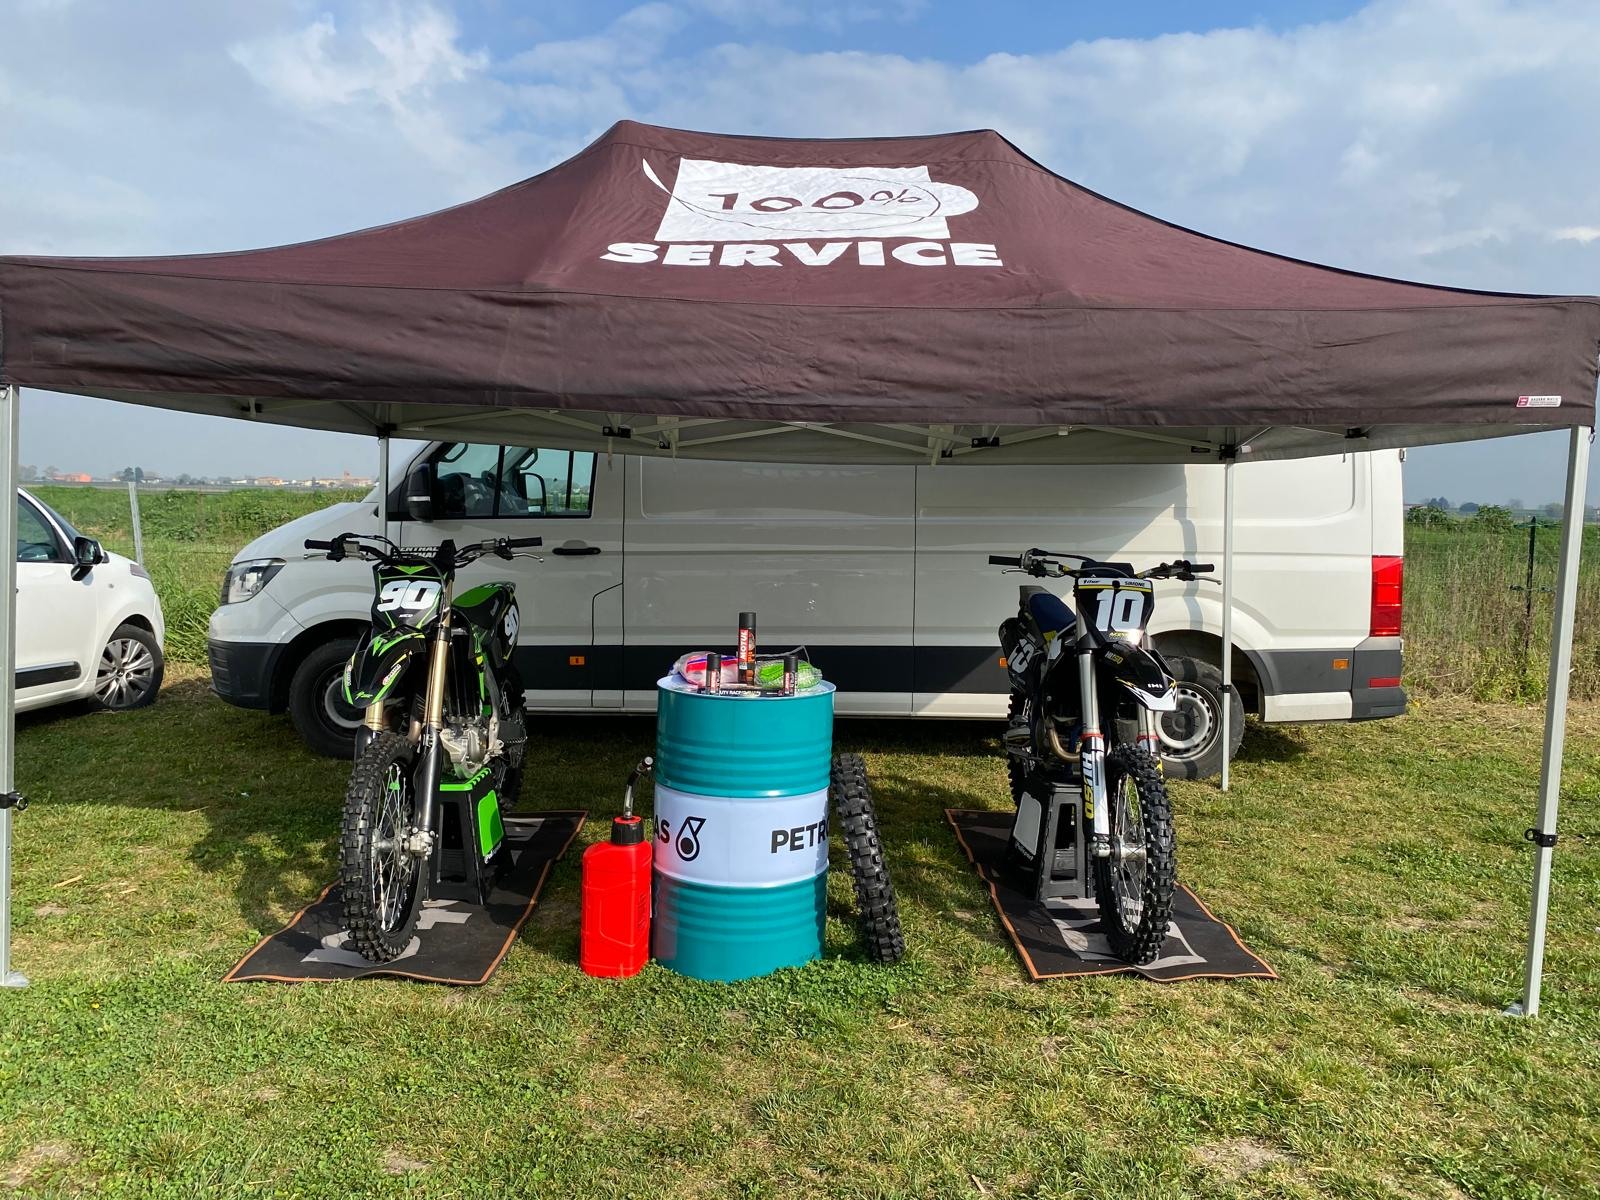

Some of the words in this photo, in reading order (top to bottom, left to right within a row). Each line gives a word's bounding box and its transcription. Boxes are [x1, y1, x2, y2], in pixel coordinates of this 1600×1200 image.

[708, 190, 921, 212] 100%
[600, 242, 1003, 266] SERVICE
[377, 580, 442, 612] 90
[1095, 588, 1145, 632] 10
[740, 630, 748, 659] MOTUL
[771, 816, 829, 854] PETR
